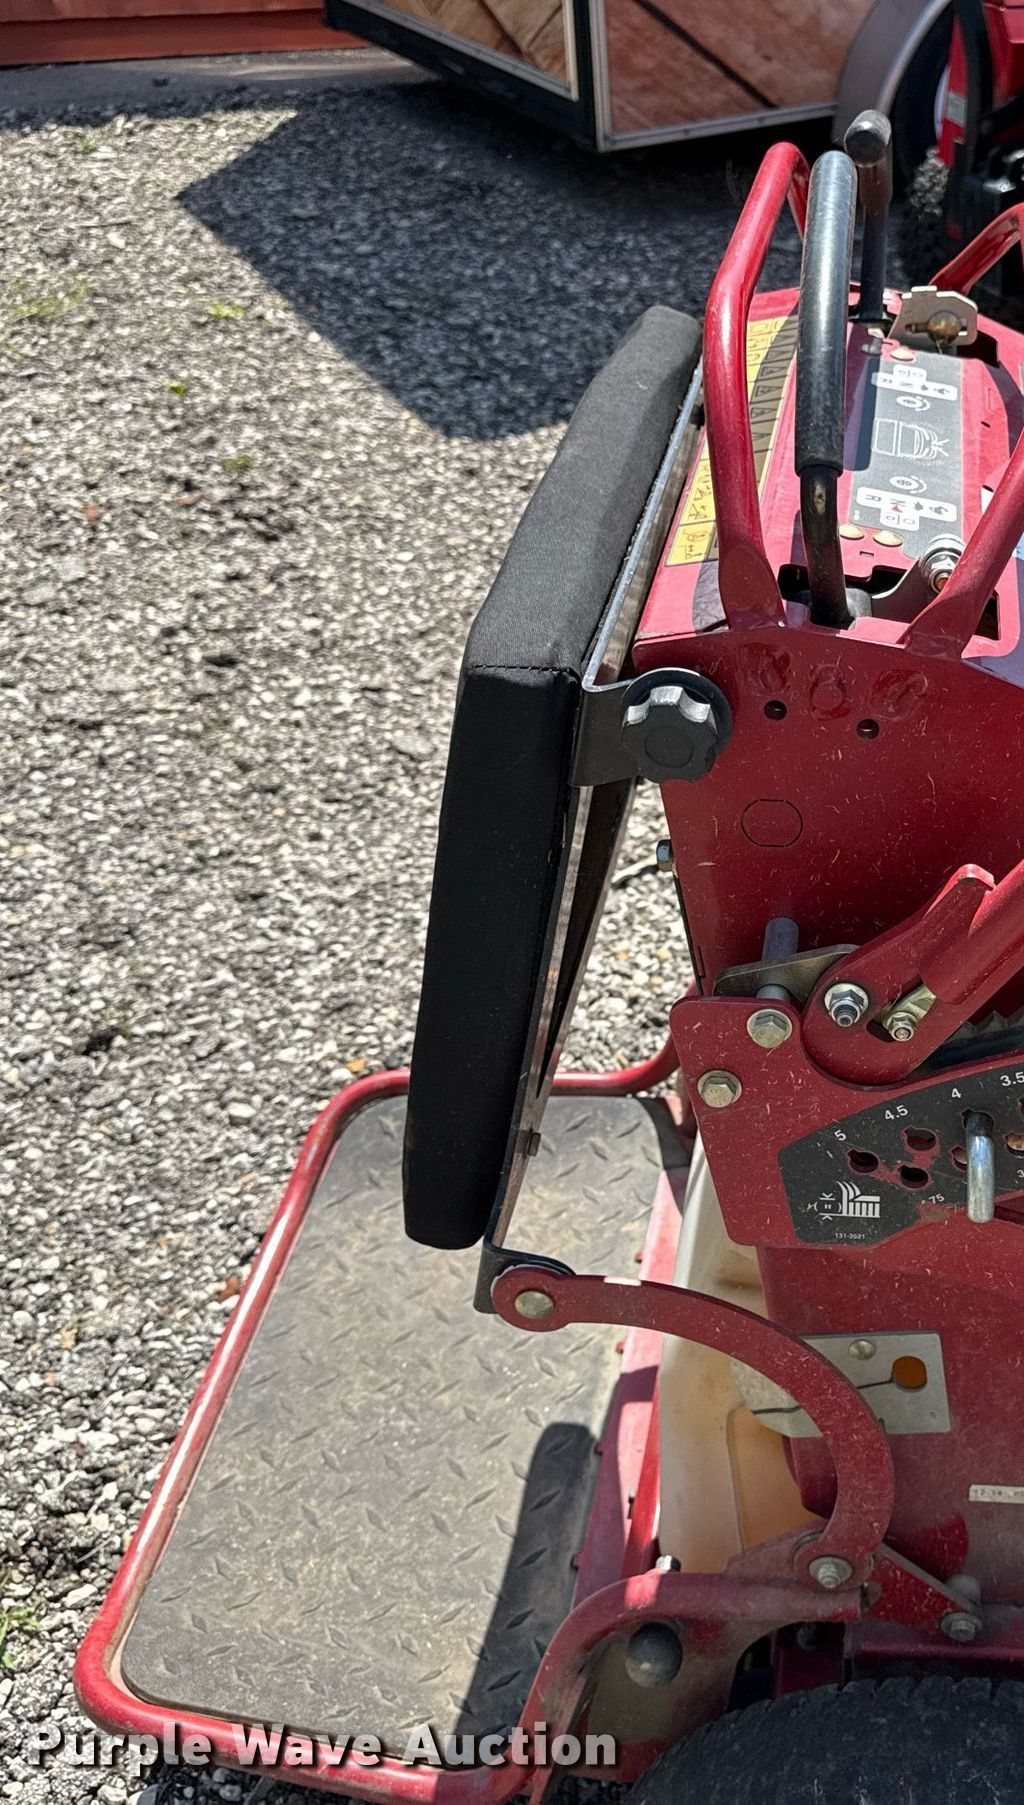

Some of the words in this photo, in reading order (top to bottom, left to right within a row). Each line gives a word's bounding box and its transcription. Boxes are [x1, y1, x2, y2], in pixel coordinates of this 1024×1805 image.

[834, 1130, 847, 1142] 5
[884, 1105, 909, 1121] 4.5
[951, 1088, 962, 1100] 4
